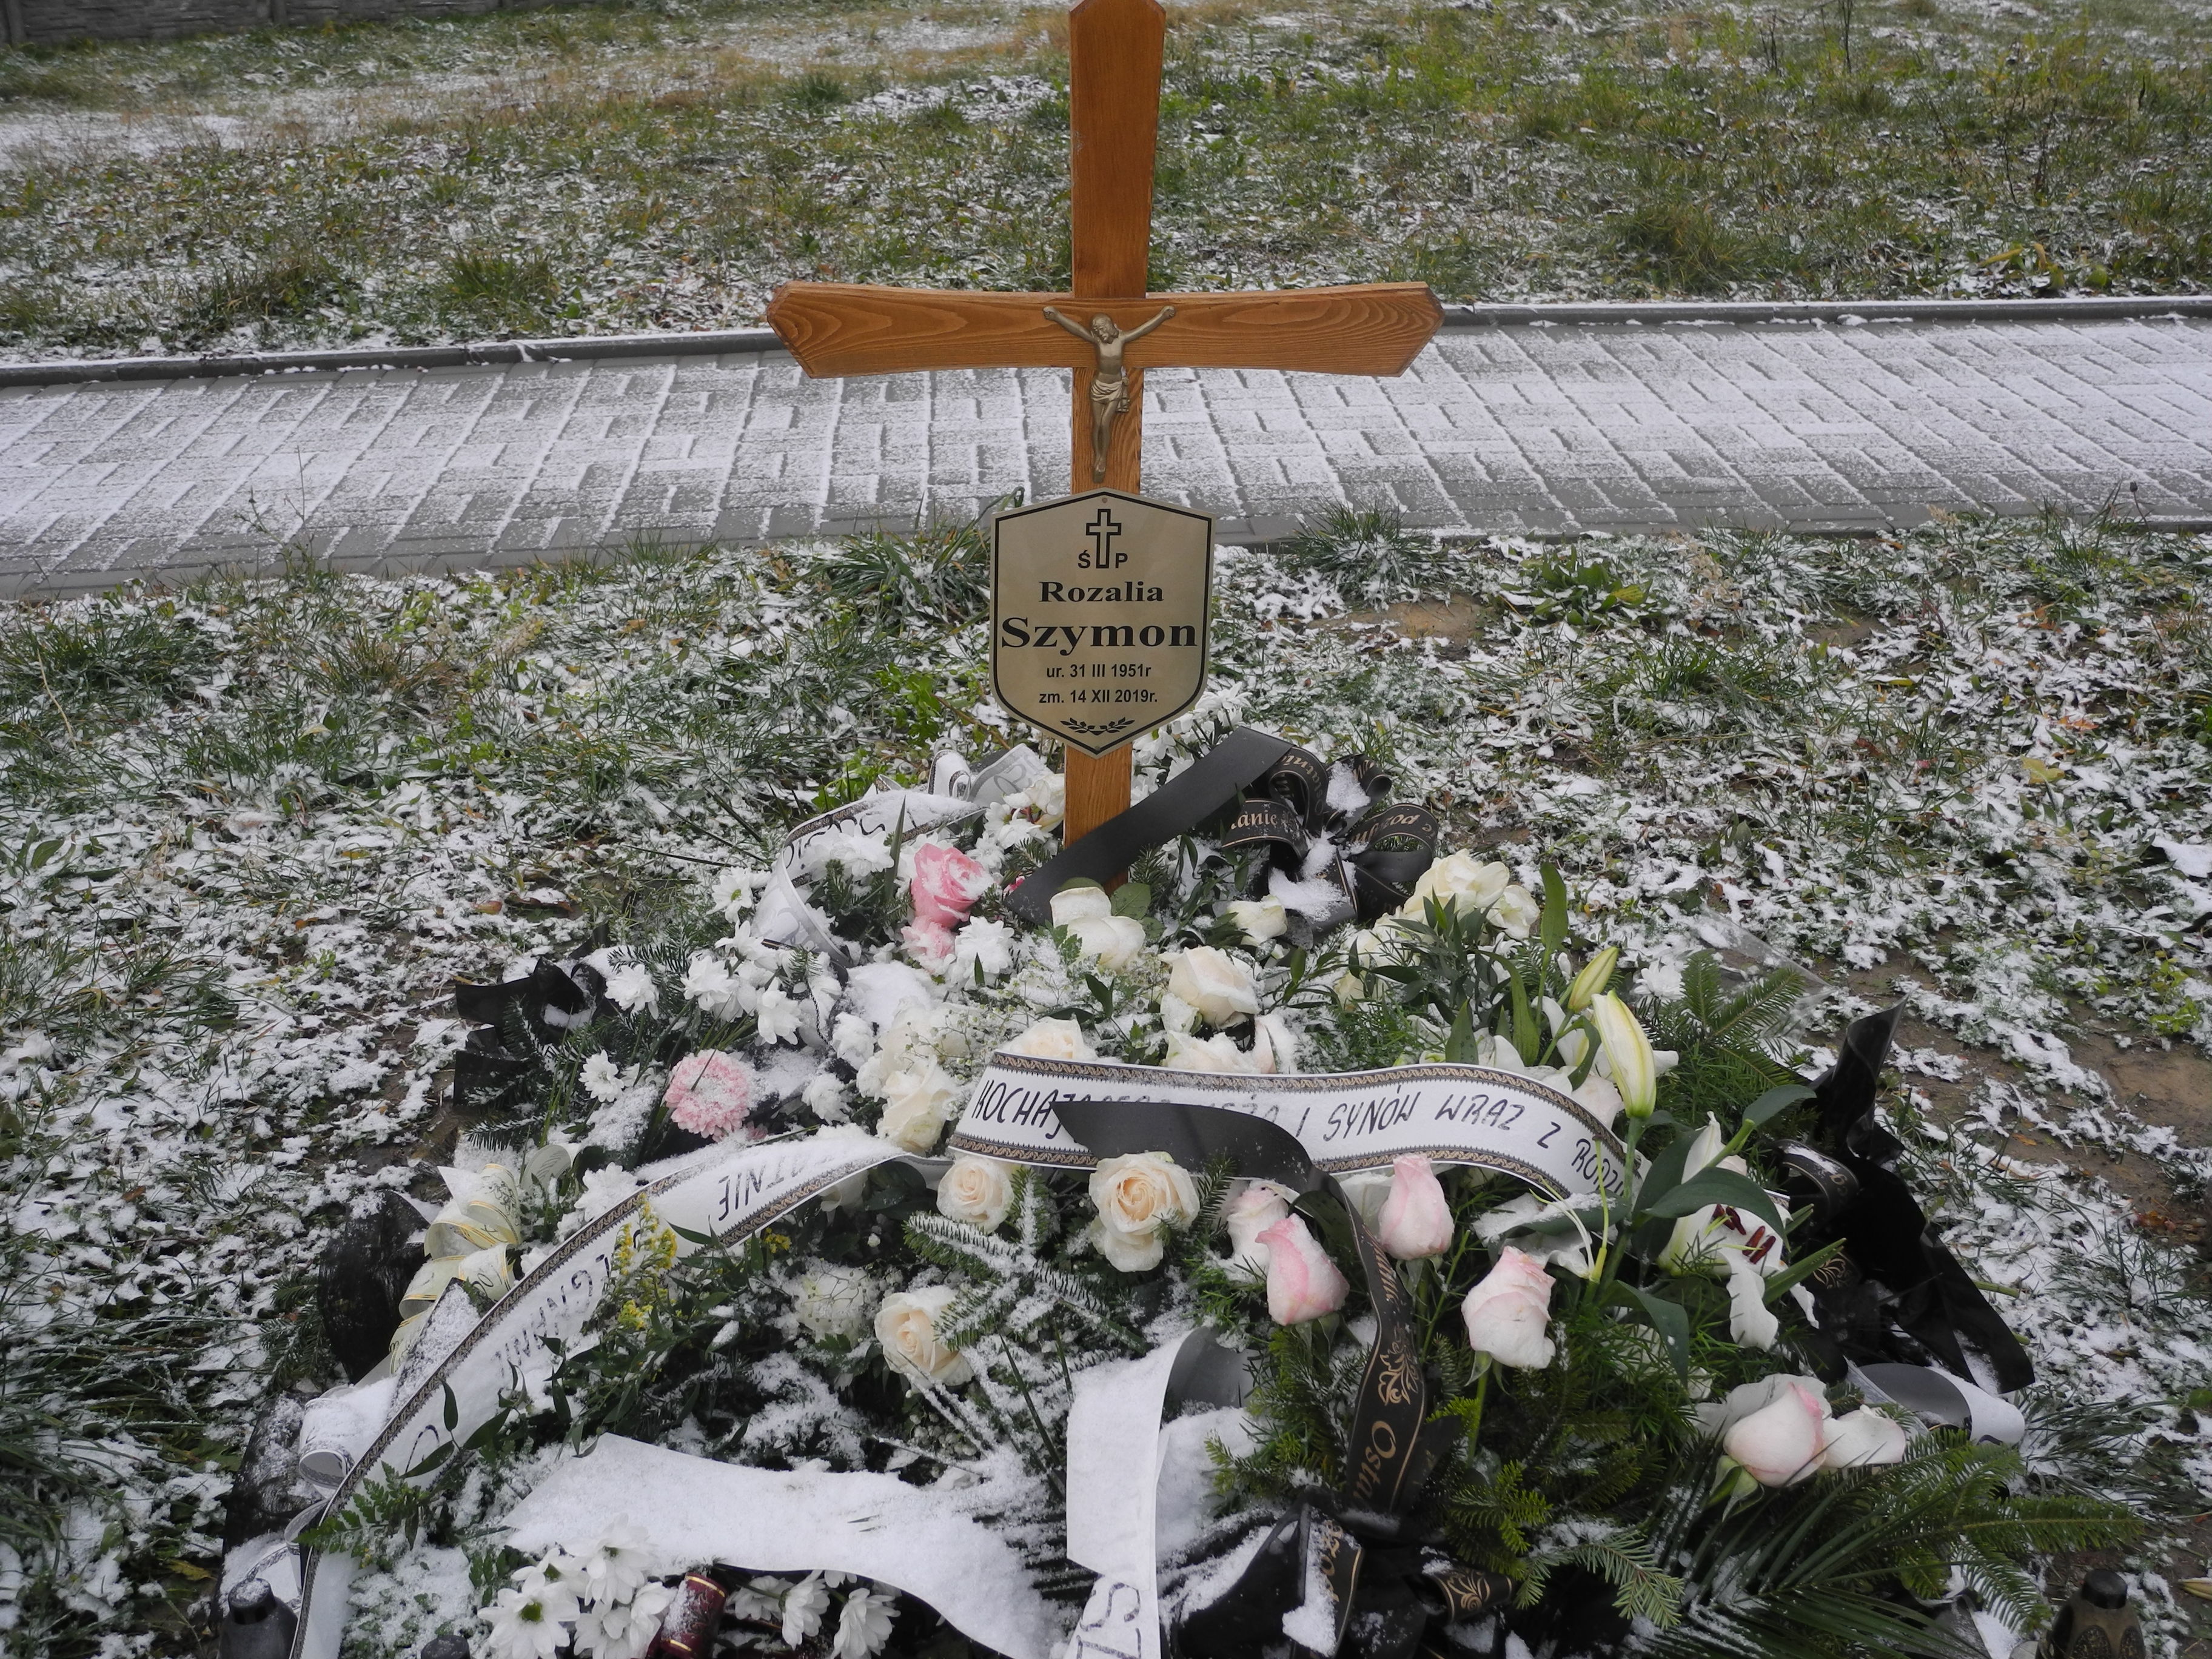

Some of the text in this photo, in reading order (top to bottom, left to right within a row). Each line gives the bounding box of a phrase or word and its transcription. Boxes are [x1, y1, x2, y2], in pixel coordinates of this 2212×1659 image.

[1078, 549, 1128, 568] Ś P
[1039, 581, 1164, 602] Rozalia
[1001, 617, 1197, 655] Szymon
[1046, 664, 1151, 678] ur. 31 III 1951r
[1039, 689, 1158, 703] zm. 14 XII 2019r.
[1435, 1094, 1526, 1131] WRAZ
[1537, 1122, 1561, 1148] Z
[1571, 1138, 1625, 1197] RODZI
